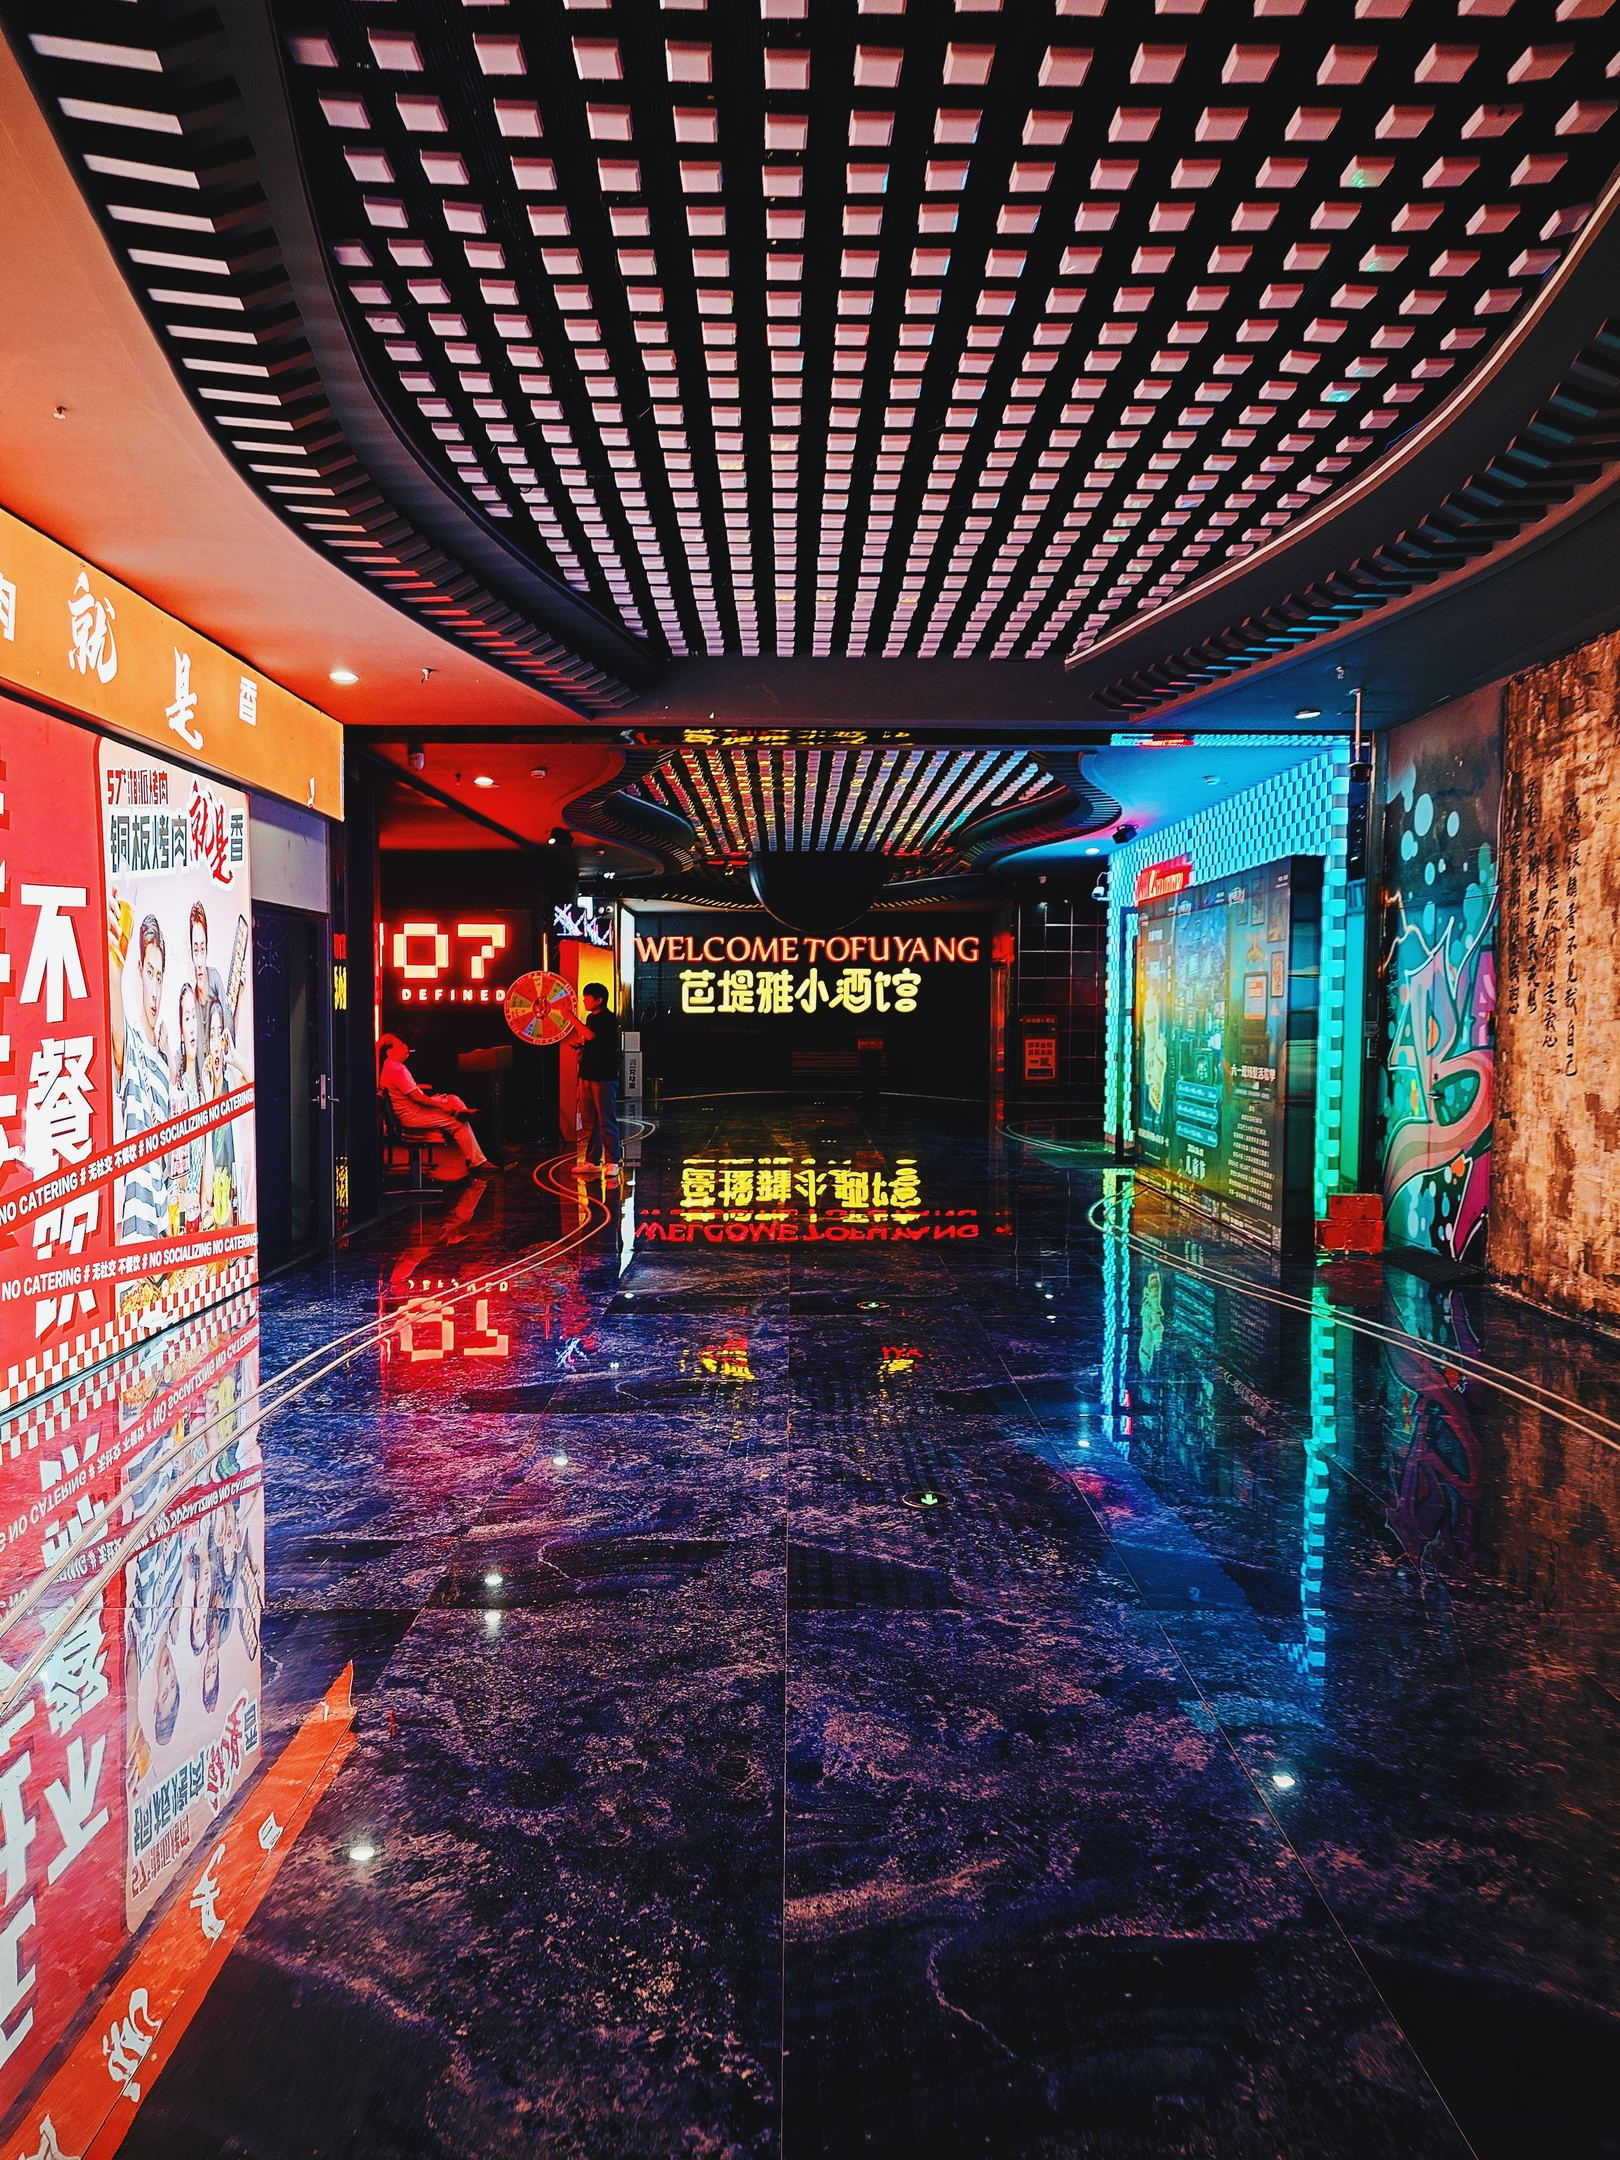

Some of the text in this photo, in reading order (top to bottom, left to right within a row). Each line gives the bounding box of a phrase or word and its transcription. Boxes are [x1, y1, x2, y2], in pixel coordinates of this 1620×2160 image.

[393, 923, 506, 979] 07
[634, 935, 799, 963] WELCOME
[402, 988, 506, 1002] DEFINED
[678, 967, 922, 1014] 芭堤雅小酒馆
[19, 1172, 78, 1214] CATERING
[145, 1133, 159, 1154] NO
[159, 1112, 208, 1146] SOCIALIZING
[208, 1105, 220, 1122] NO
[1, 1279, 22, 1300] NO
[23, 1267, 82, 1296] CATERING
[148, 1249, 163, 1269] NO
[163, 1241, 212, 1265] SOCIALIZING
[212, 1239, 224, 1255] NO
